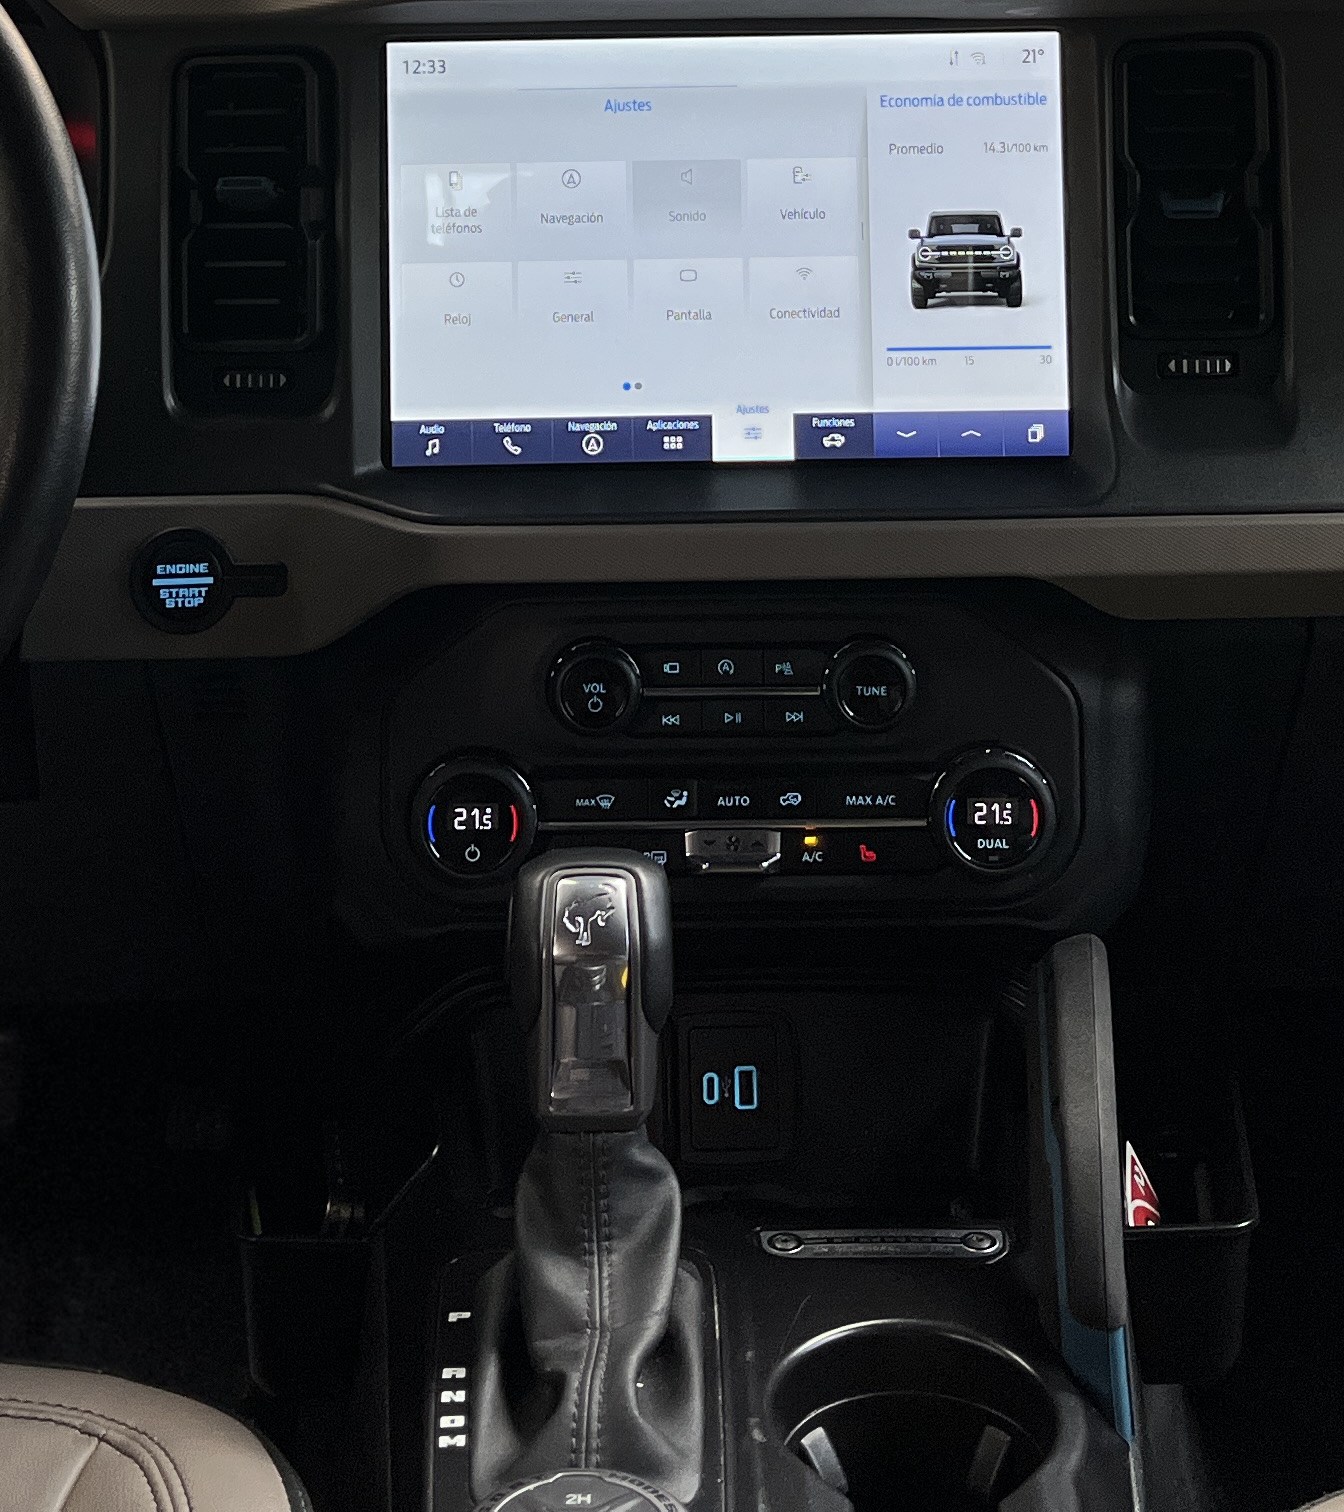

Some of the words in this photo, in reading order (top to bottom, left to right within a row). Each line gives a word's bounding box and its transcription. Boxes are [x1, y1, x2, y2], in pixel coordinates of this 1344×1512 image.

[1021, 48, 1045, 64] 21°
[402, 59, 447, 75] 12:33
[604, 98, 652, 114] Ajustes
[879, 93, 945, 108] Economía
[947, 93, 964, 107] de
[966, 91, 1048, 107] combustible
[888, 142, 944, 155] Promedio
[1033, 142, 1049, 153] km
[435, 205, 461, 218] Lista
[463, 205, 478, 218] de
[540, 210, 604, 225] Navegación
[668, 209, 707, 222] Sonido
[779, 207, 826, 221] Vehículo
[430, 221, 483, 234] teléfonos
[552, 310, 595, 324] General
[665, 308, 713, 321] Pantalla
[769, 306, 841, 320] Conectividad
[443, 313, 472, 327] Reloj
[922, 356, 938, 367] km
[964, 355, 975, 366] 15
[1039, 354, 1053, 365] 30
[736, 403, 770, 416] Ajustes
[419, 423, 445, 435] Audio
[493, 421, 532, 434] Teléfono
[567, 420, 618, 434] Navegación
[646, 418, 700, 433] Aplicaciones
[812, 416, 856, 429] Funciones
[156, 562, 209, 575] ENGINE
[159, 586, 209, 599] START
[165, 596, 205, 609] STOP
[582, 682, 607, 694] VOL
[856, 685, 888, 697] TUNE
[575, 798, 596, 807] MAX
[717, 795, 750, 808] AUTO
[845, 794, 873, 807] MAX
[874, 794, 897, 808] A/C
[976, 837, 1010, 849] DUAL
[802, 850, 824, 863] A/C
[440, 1390, 466, 1403] N
[438, 1434, 467, 1448] M
[565, 1492, 592, 1506] 2H
